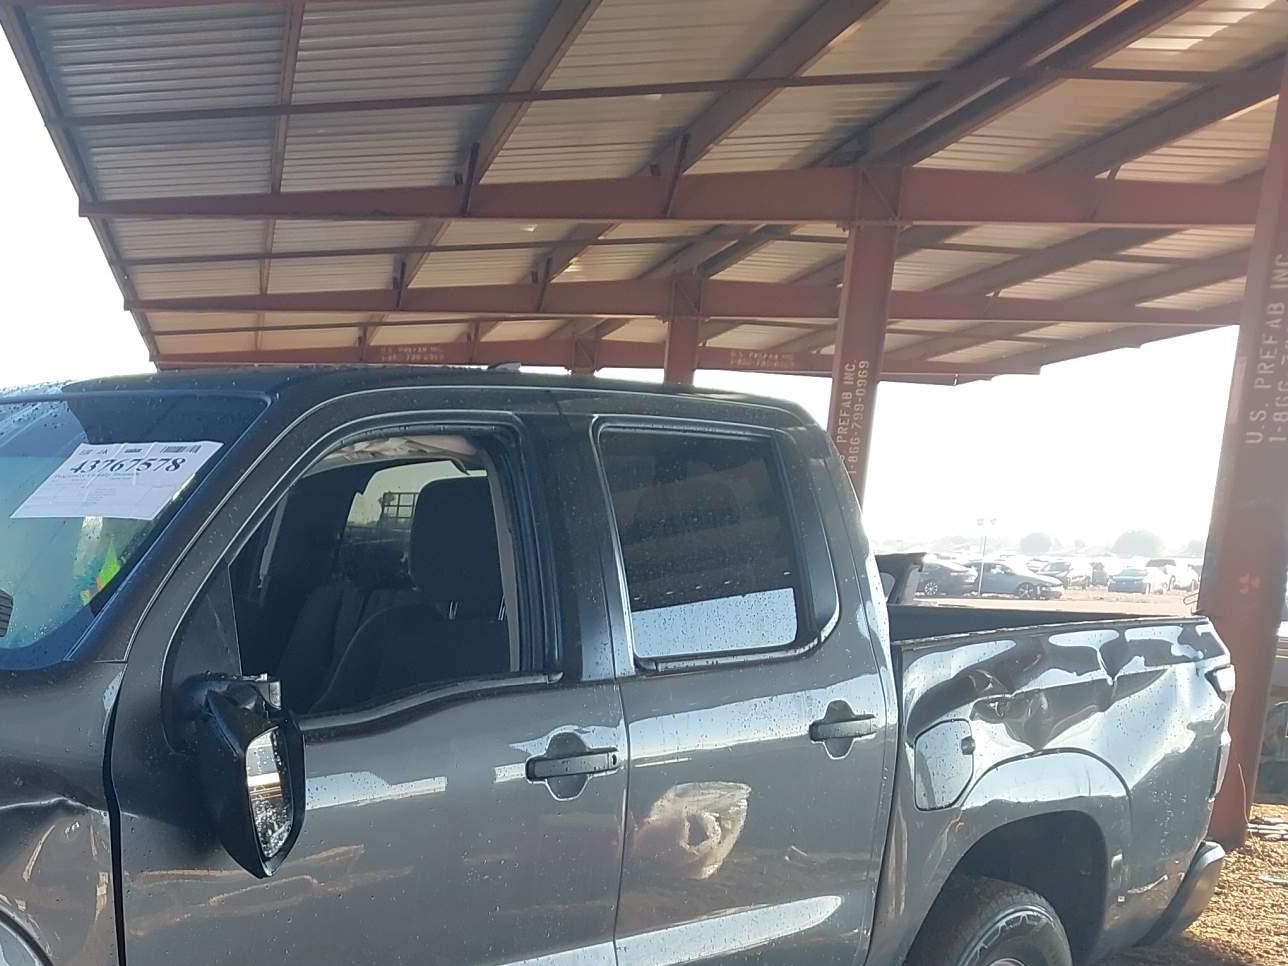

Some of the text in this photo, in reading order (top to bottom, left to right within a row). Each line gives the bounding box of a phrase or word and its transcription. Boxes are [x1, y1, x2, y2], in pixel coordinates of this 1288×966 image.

[1255, 302, 1286, 389] PREFAB
[836, 391, 853, 443] PREFAB
[1245, 402, 1269, 444] U.S.
[69, 457, 187, 474] 43767578
